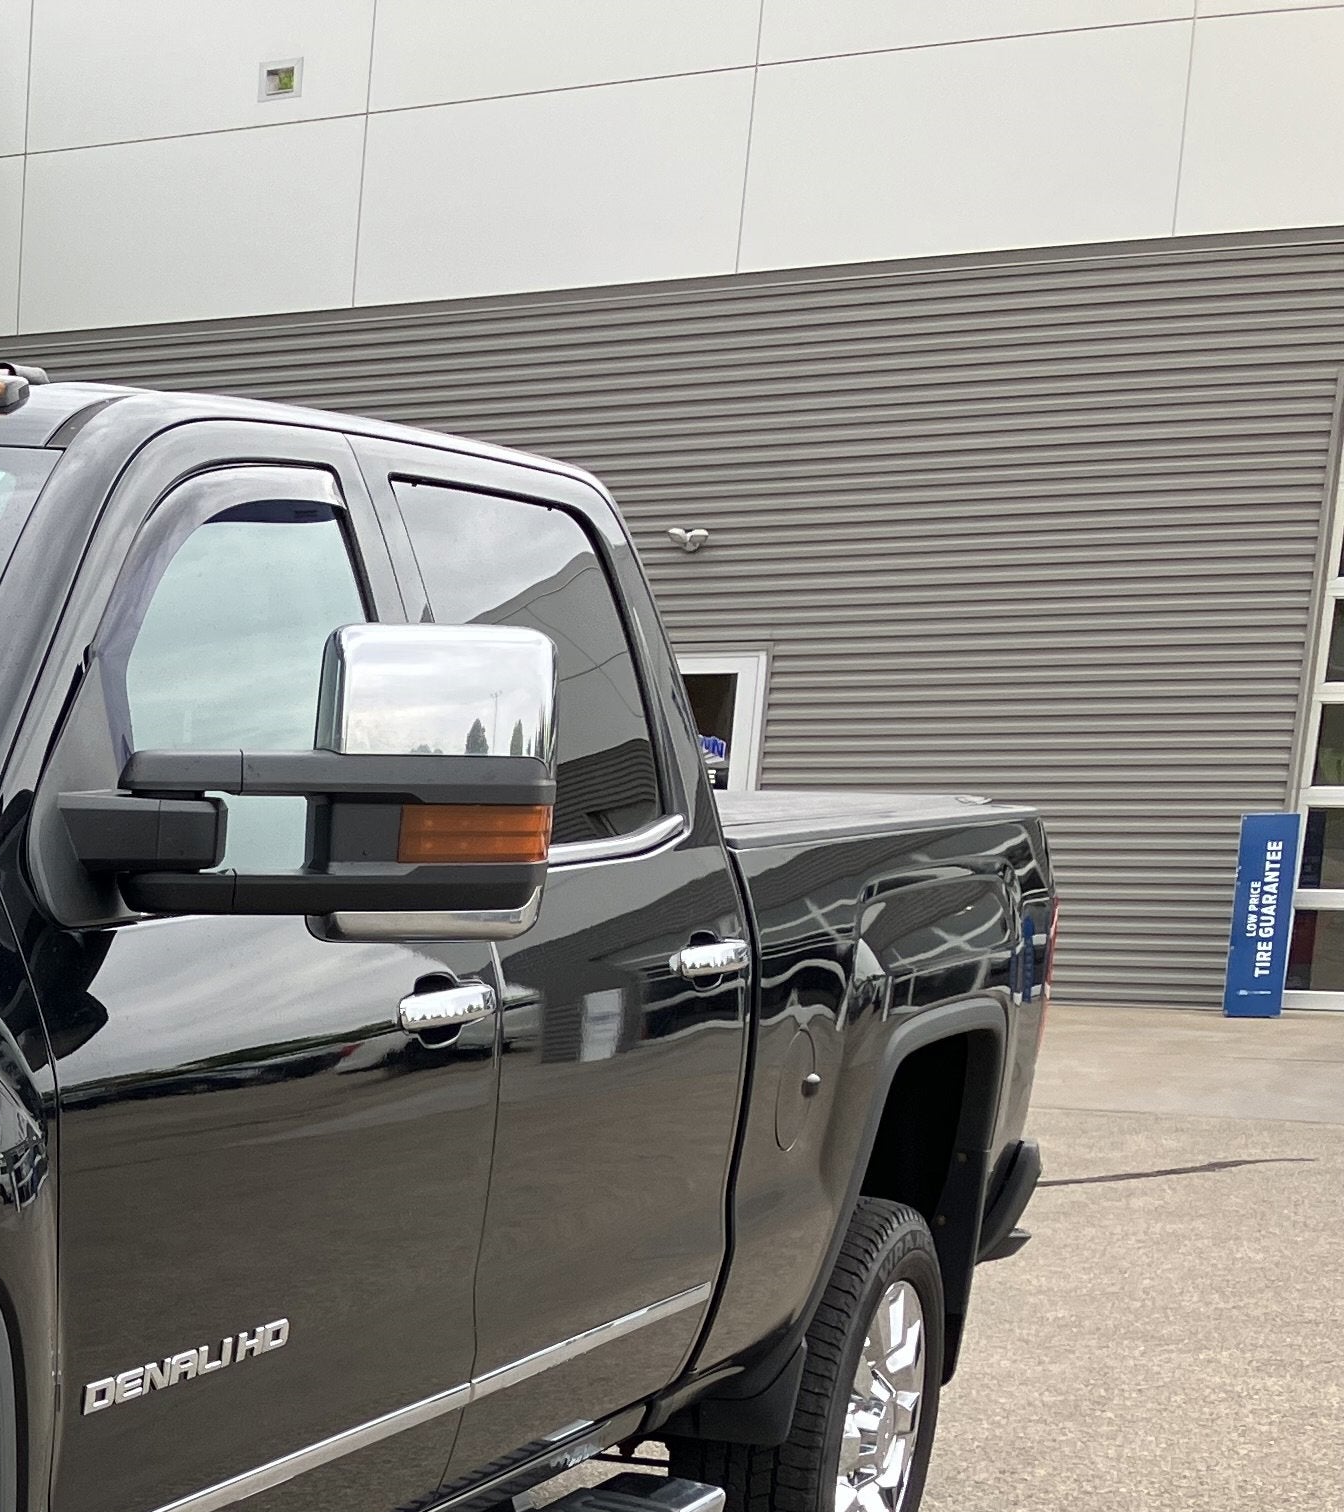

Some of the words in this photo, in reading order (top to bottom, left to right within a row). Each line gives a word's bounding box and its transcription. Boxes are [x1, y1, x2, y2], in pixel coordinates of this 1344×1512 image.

[1249, 880, 1262, 912] PRICE
[1259, 840, 1284, 938] GUARANTEE
[1246, 912, 1258, 937] LOW
[1254, 940, 1273, 978] TIRE
[82, 1336, 233, 1416] DENALI
[235, 1317, 290, 1364] HD
